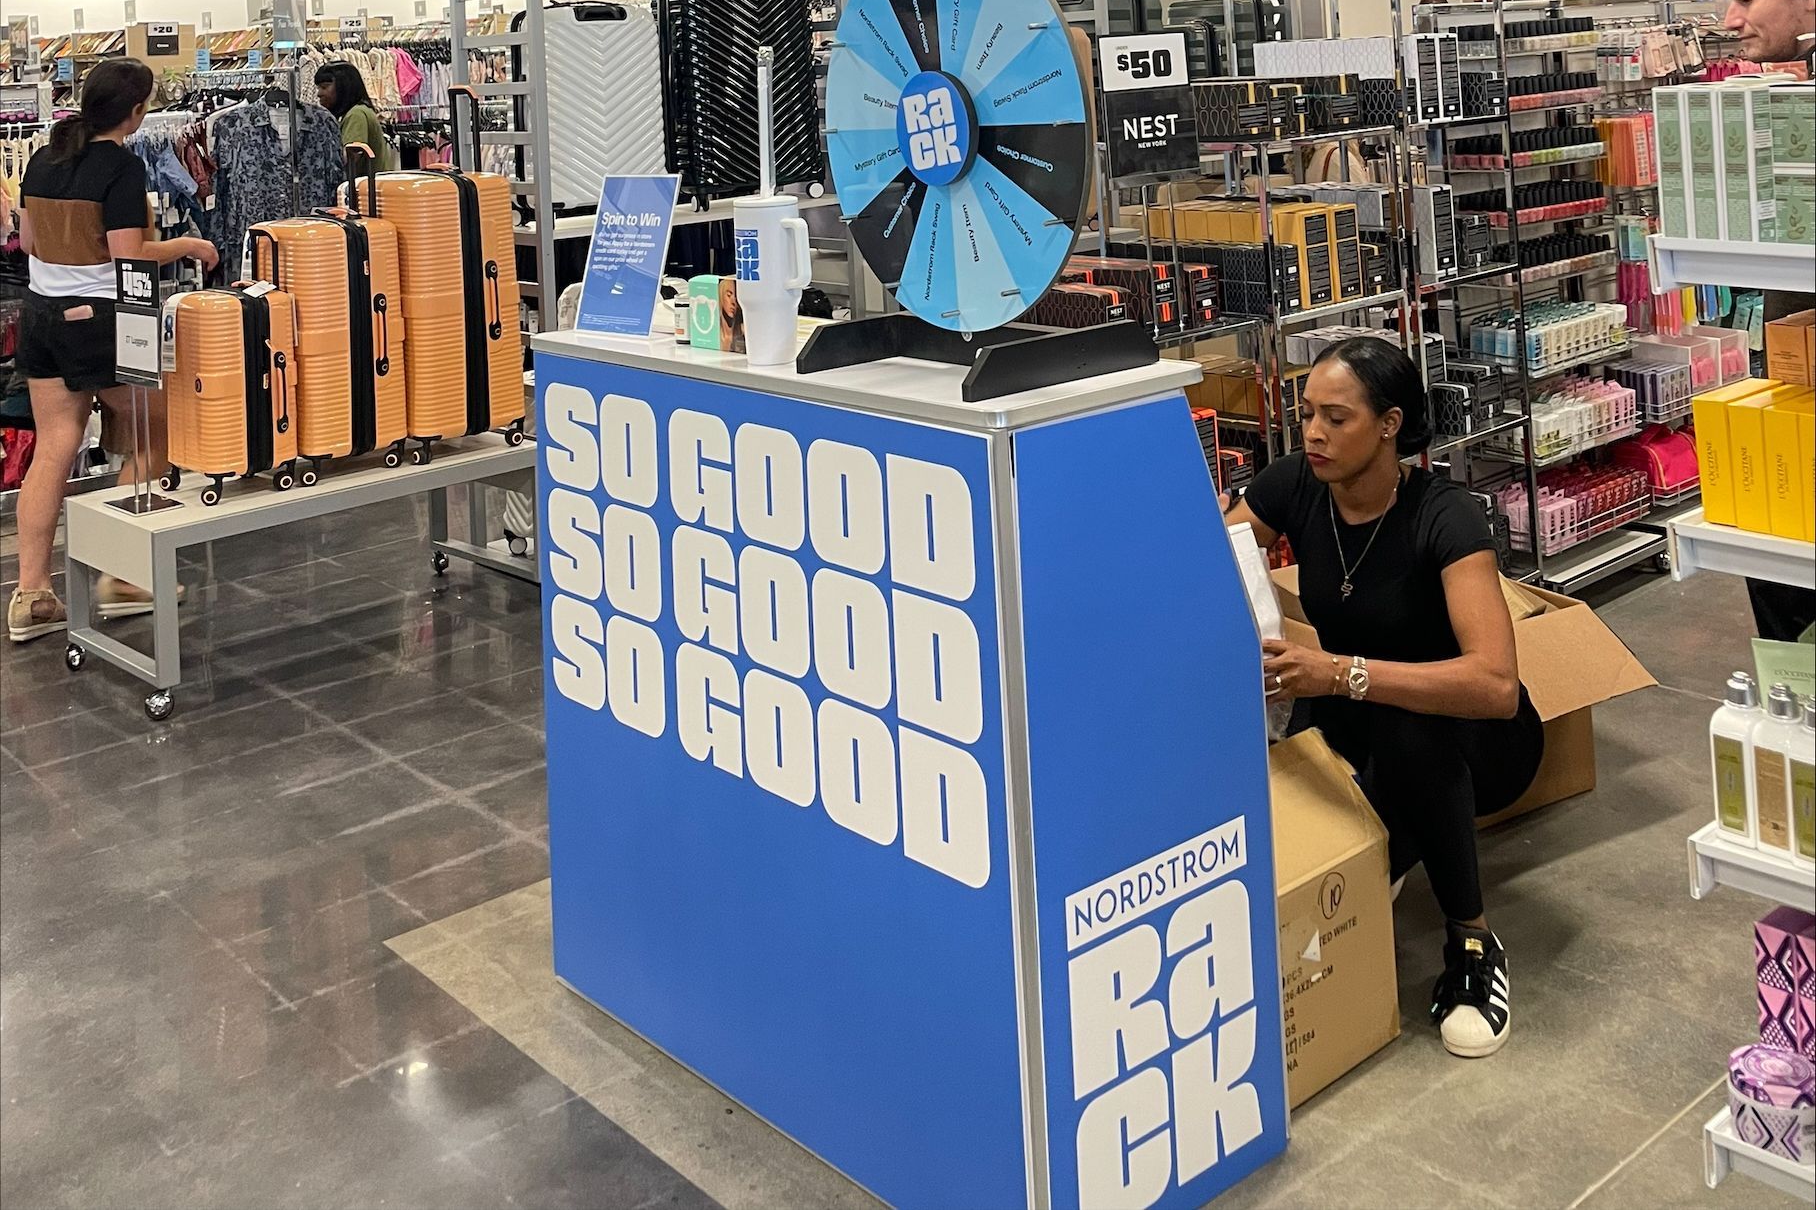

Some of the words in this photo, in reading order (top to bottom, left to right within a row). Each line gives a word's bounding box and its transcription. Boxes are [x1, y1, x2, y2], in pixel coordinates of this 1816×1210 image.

[952, 10, 960, 28] Gift
[858, 9, 884, 43] Nordstrom
[882, 41, 895, 58] Rack
[918, 22, 930, 54] Choice
[950, 29, 958, 51] Card
[985, 22, 1004, 52] Beauty
[976, 49, 989, 71] Item
[1117, 49, 1172, 79] $50
[1011, 85, 1028, 100] Rack
[1026, 69, 1063, 93] Nordstrom
[863, 93, 883, 109] Beauty
[993, 94, 1012, 109] Swag
[1123, 113, 1179, 141] NEST
[996, 144, 1021, 161] Choice
[1152, 140, 1167, 148] YORK
[854, 156, 876, 172] Mystery
[876, 150, 888, 163] Gift
[1019, 152, 1054, 173] Customer
[984, 181, 999, 201] Card
[602, 212, 625, 228] Spin
[626, 214, 638, 226] to
[640, 213, 661, 226] Win
[883, 203, 904, 239] Customer
[900, 181, 916, 207] Choice
[932, 202, 941, 229] Swag
[962, 203, 972, 228] Item
[998, 199, 1010, 216] Gift
[929, 228, 938, 253] Rack
[1009, 213, 1033, 246] Mystery
[968, 227, 980, 263] Beauty
[924, 253, 936, 301] Nordstrom
[1156, 282, 1171, 291] NEST
[545, 382, 658, 508] SO
[668, 408, 976, 602] GOOD
[548, 486, 662, 623] SO
[672, 524, 984, 745] GOOD
[551, 593, 666, 738] SO
[676, 641, 991, 889] GOOD
[1074, 829, 1239, 936] NORDSTROM
[1329, 883, 1342, 913] 10
[1333, 916, 1357, 937] WHITE
